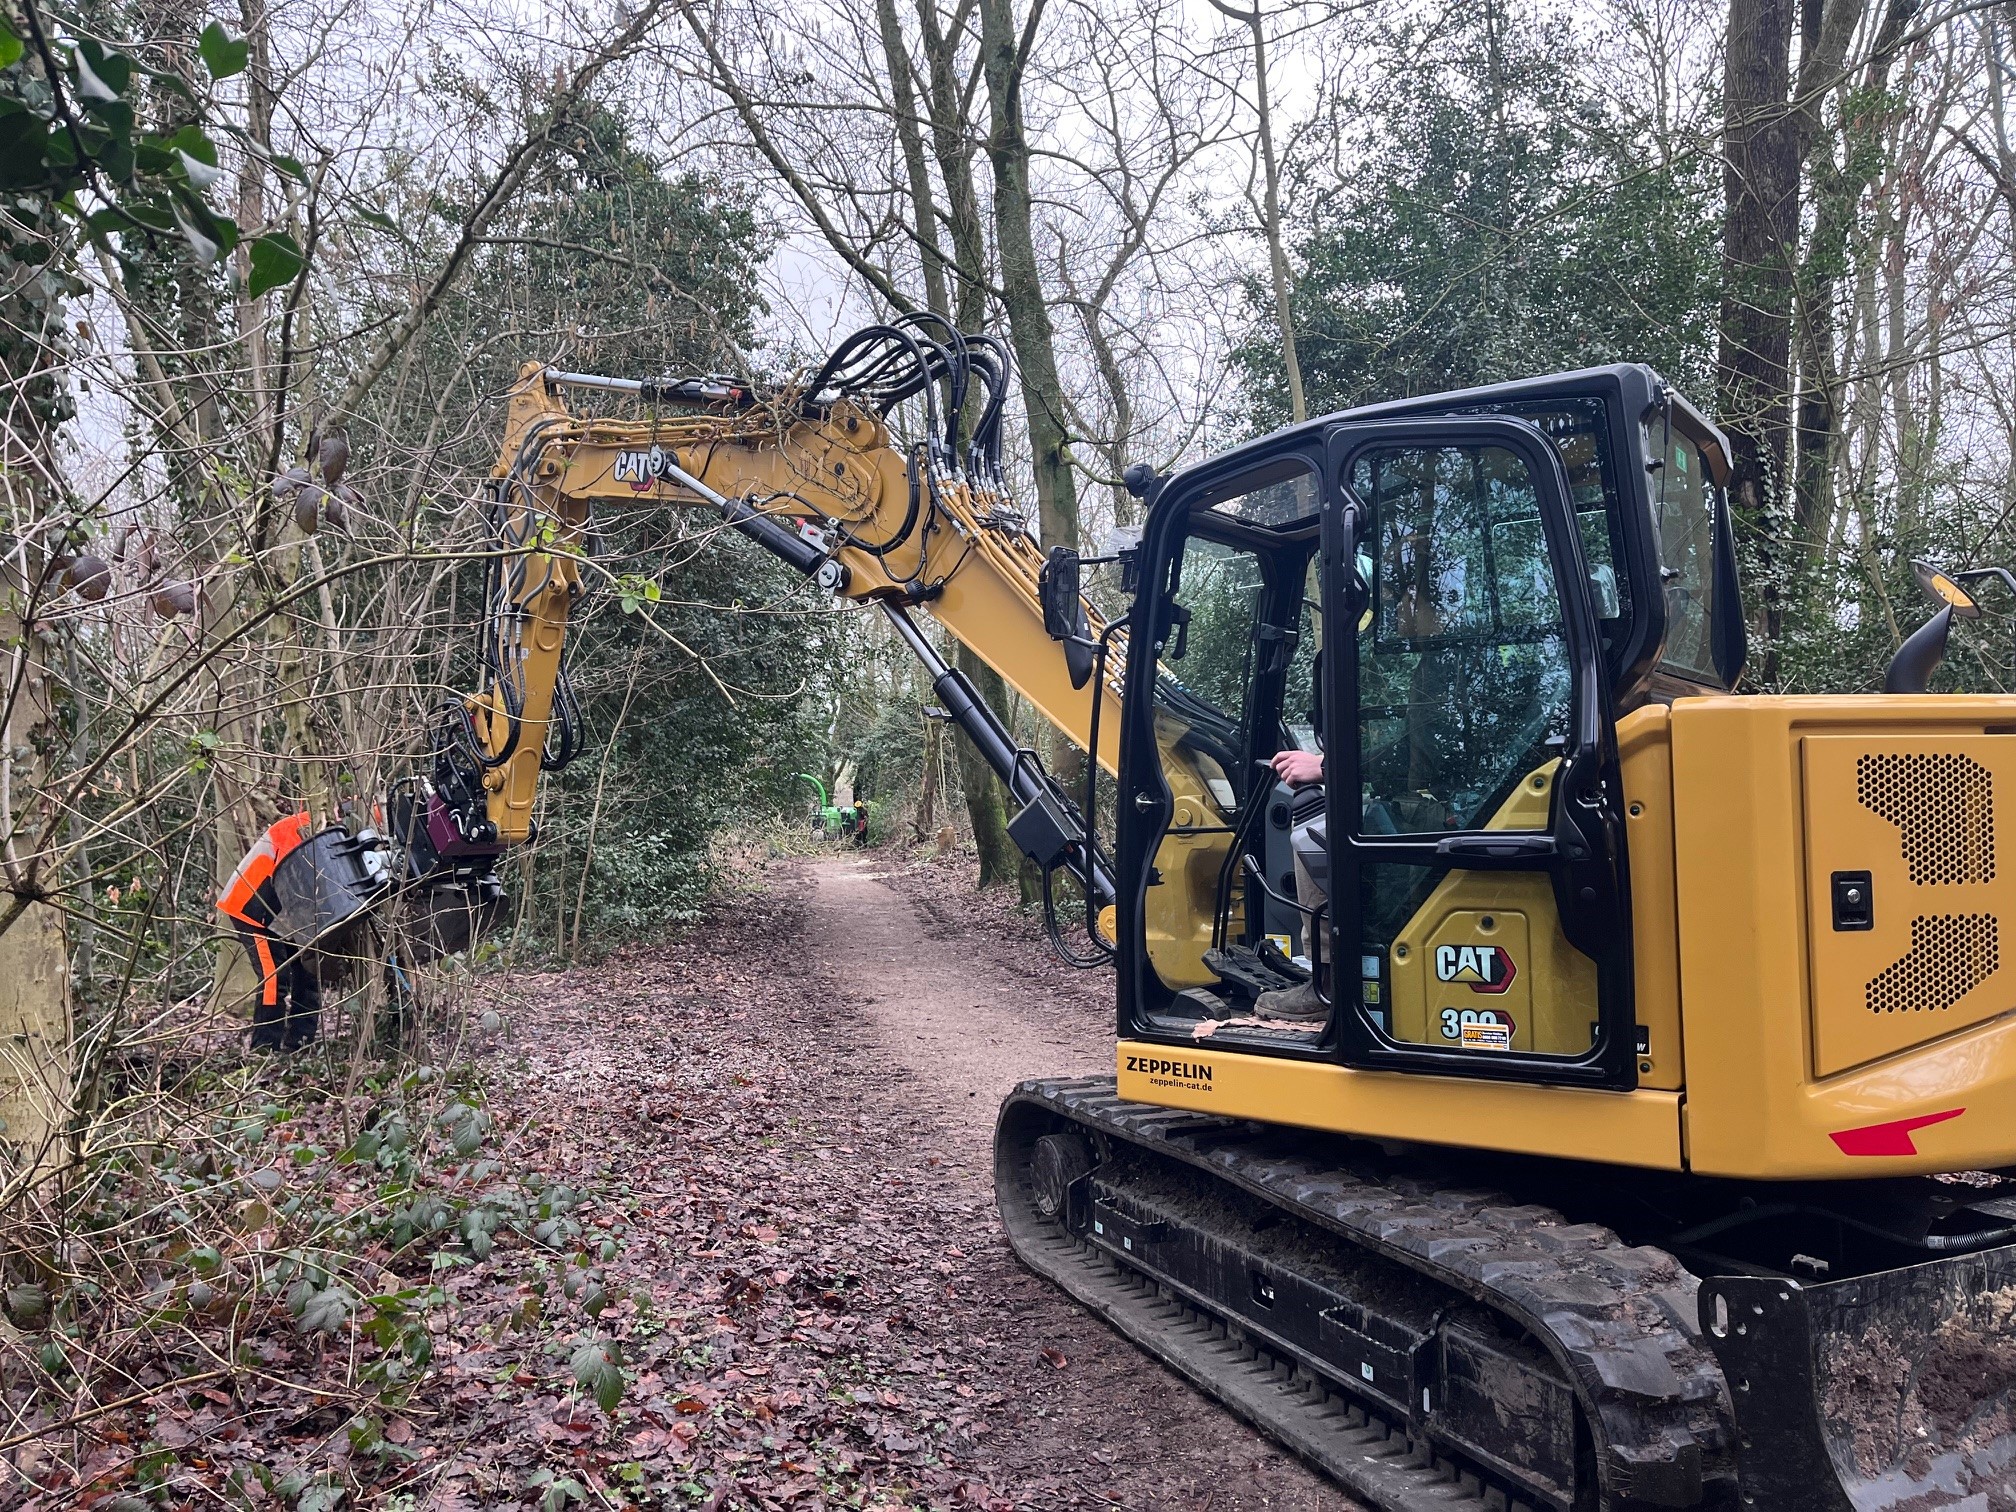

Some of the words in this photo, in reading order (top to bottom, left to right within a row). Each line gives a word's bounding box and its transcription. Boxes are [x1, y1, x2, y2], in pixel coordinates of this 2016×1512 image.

[615, 451, 649, 482] CAT
[1436, 945, 1495, 982] CAT
[1464, 1030, 1482, 1039] GRATIS
[1126, 1056, 1212, 1081] ZEPPELIN
[1150, 1077, 1212, 1092] zeppelin-cat.de
